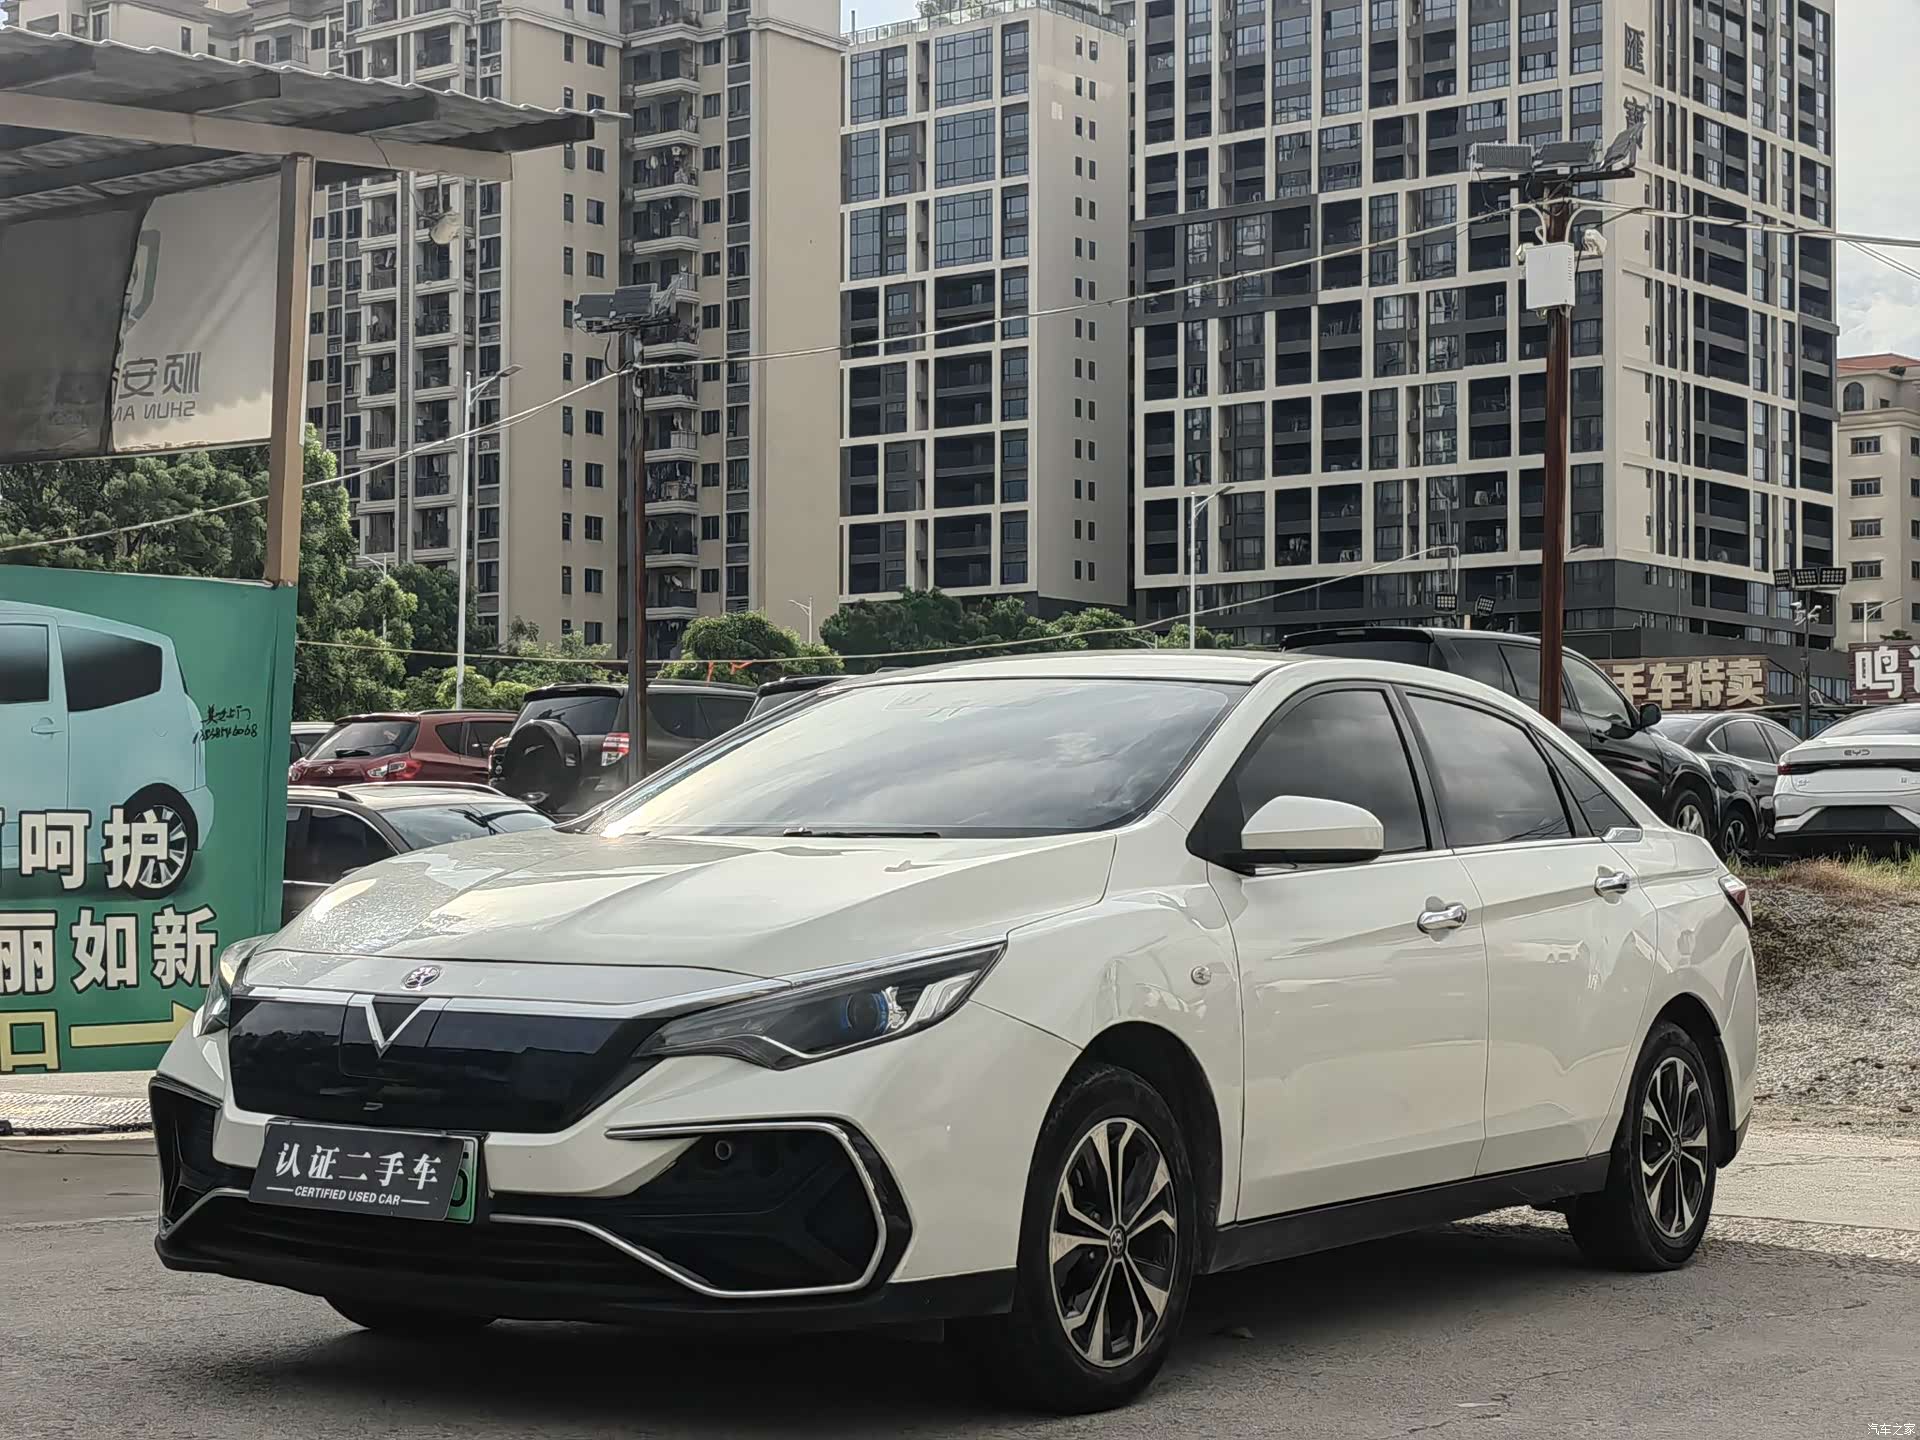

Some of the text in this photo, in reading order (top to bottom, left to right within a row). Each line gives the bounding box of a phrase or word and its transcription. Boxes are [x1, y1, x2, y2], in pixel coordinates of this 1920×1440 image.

[1600, 658, 1764, 709] 手车特卖
[1855, 645, 1920, 698] 鸣
[0, 806, 169, 889] 呵护
[275, 1142, 441, 1190] 认证二手车
[294, 1185, 401, 1206] CERTIFIED USED CAR
